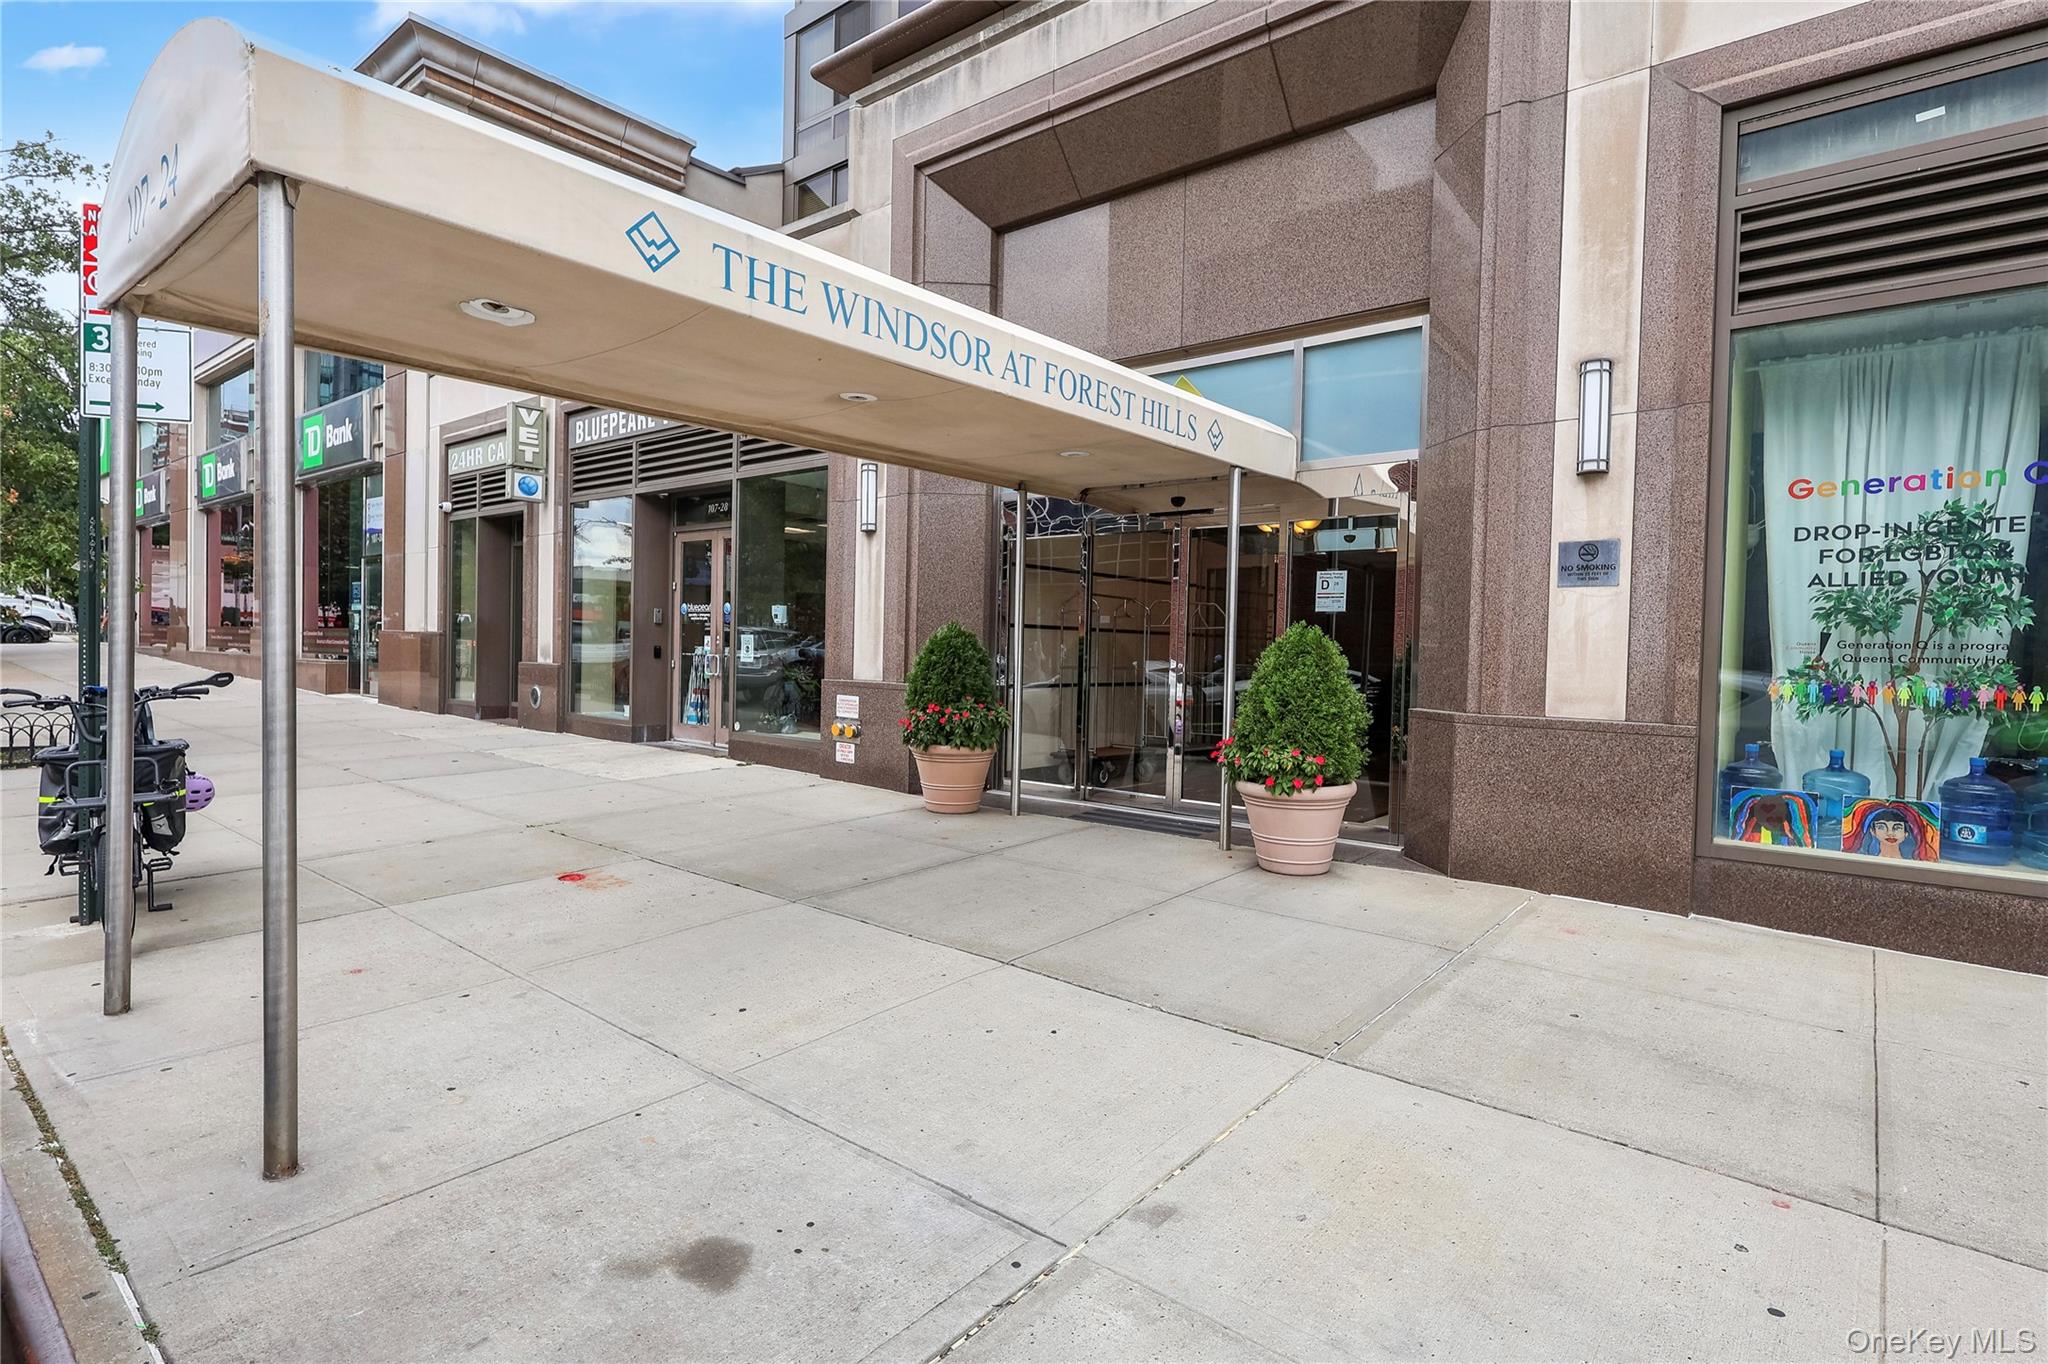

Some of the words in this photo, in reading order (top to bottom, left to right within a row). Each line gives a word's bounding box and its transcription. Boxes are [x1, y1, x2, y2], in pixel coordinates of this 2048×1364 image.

[127, 143, 178, 243] 107-24
[91, 326, 109, 350] 3
[138, 340, 157, 349] ered
[712, 243, 808, 315] THE
[820, 281, 993, 376] WINDSOR
[1001, 349, 1036, 388] AT
[1043, 361, 1136, 421] FOREST
[1141, 396, 1197, 441] HILLS
[89, 362, 111, 372] 8:30
[137, 367, 163, 377] 10pm
[89, 374, 111, 384] Exce
[137, 378, 161, 389] nday
[304, 427, 321, 457] TD
[326, 417, 353, 449] Bank
[518, 407, 541, 463] VET
[451, 447, 483, 471] 24HR
[488, 442, 506, 463] CA
[203, 463, 215, 489] TD
[217, 459, 235, 482] Bank
[1787, 466, 2007, 500] Generation
[708, 502, 729, 514] 107-28
[1794, 521, 1913, 542] DROP-IN
[1924, 516, 2027, 537] CENTE
[1819, 547, 1881, 564] FOR
[1886, 543, 1985, 562] LGBTQ
[1576, 563, 1617, 572] SMOKING
[1808, 570, 1908, 588] ALLIED
[1918, 567, 2026, 586] YOUTH
[1321, 580, 1330, 590] D
[1837, 640, 1911, 650] Generation
[1916, 640, 1929, 650] Q
[1933, 640, 1943, 650] is
[1960, 643, 2009, 653] progra
[1842, 654, 1894, 664] Queens
[1898, 654, 1980, 667] Community
